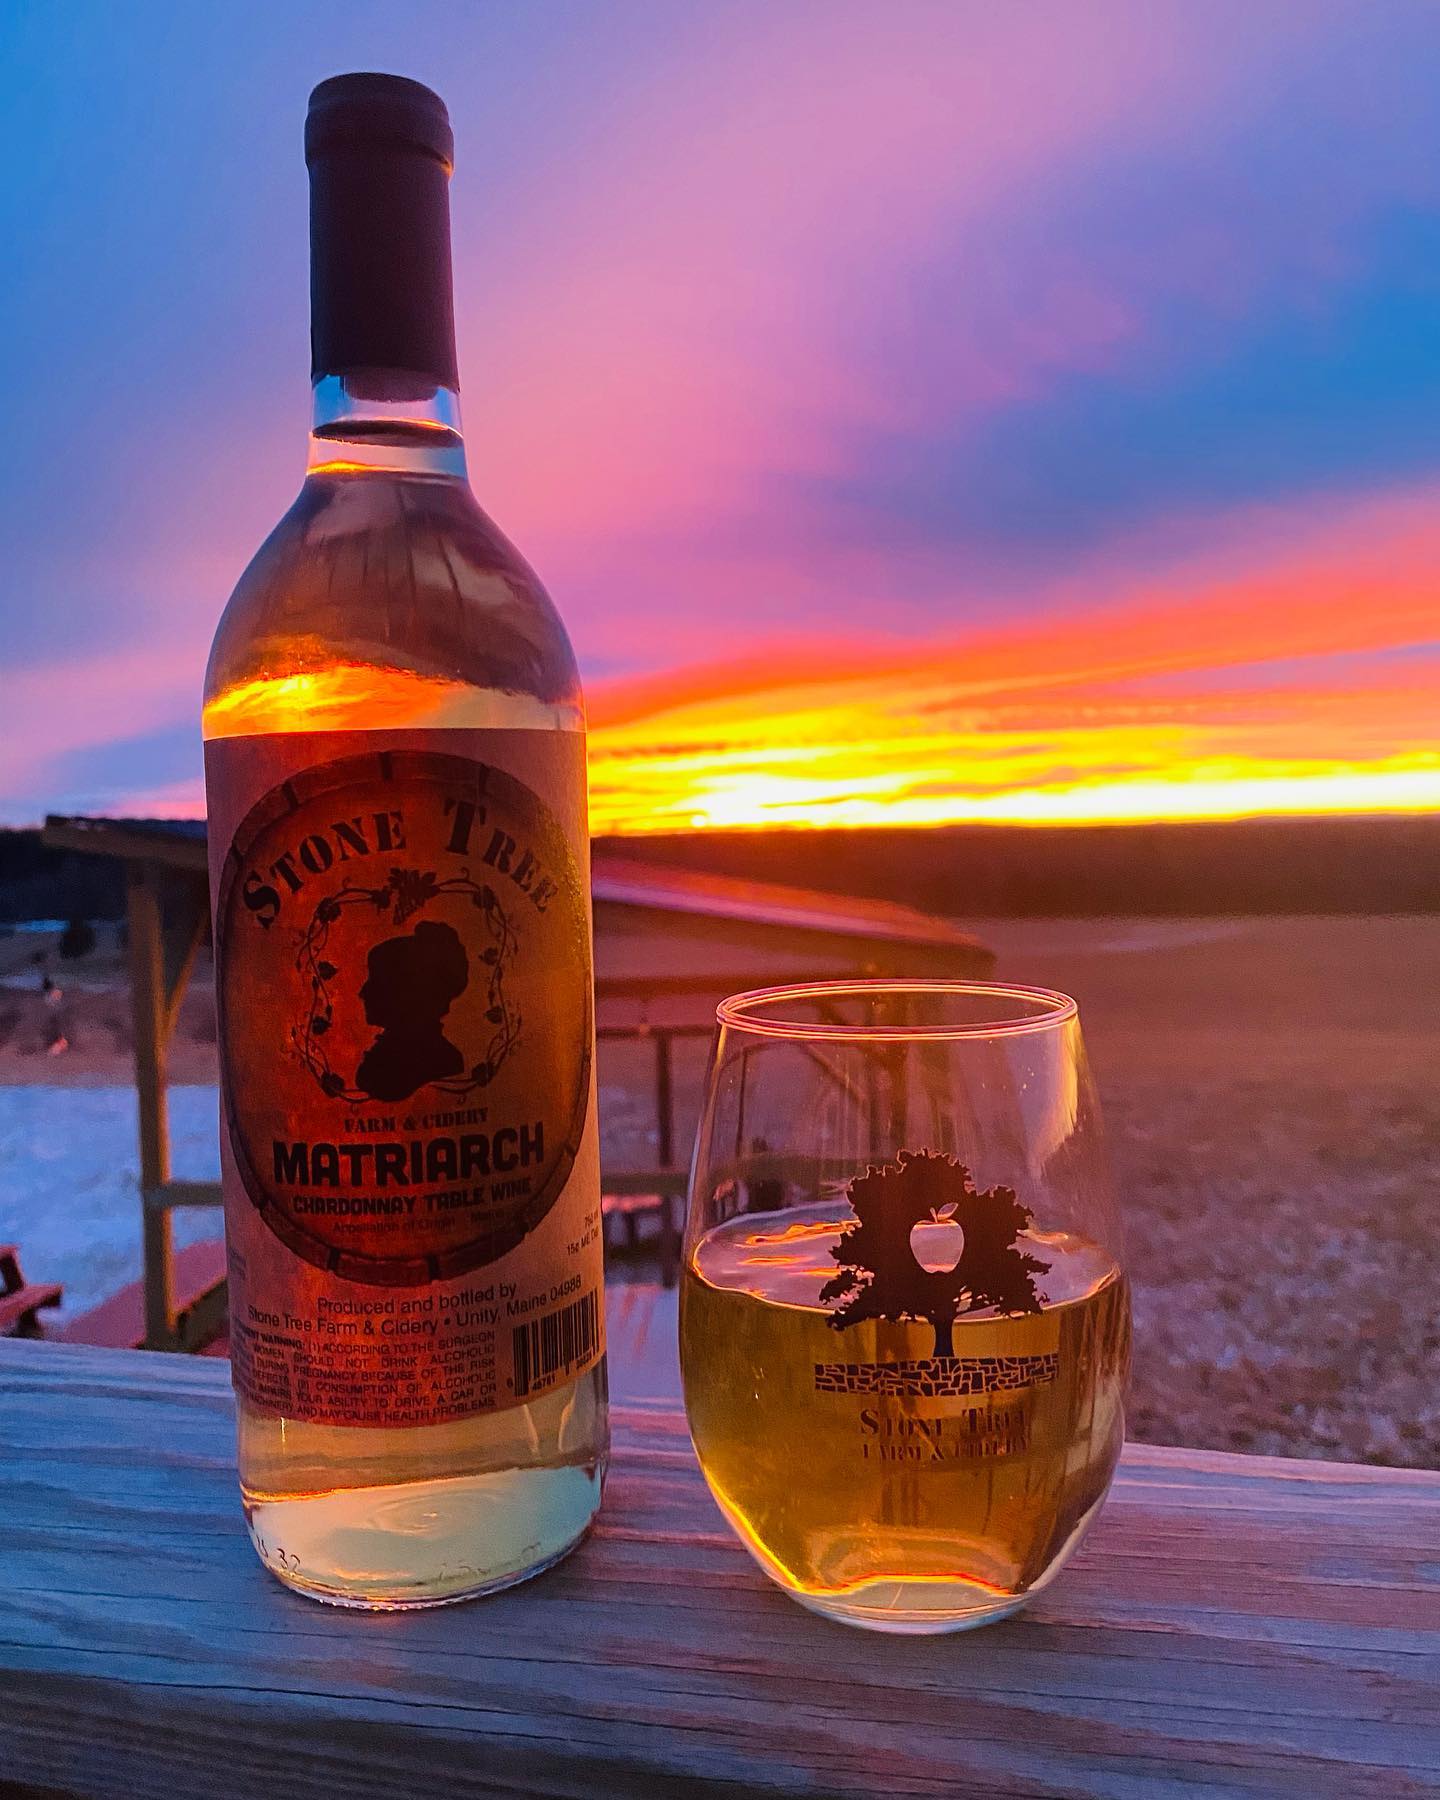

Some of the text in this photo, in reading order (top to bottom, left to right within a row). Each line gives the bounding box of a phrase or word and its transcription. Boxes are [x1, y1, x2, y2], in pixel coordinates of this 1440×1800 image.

[242, 797, 559, 931] STONE TREE
[271, 1120, 545, 1188] MATRIARCH
[293, 1176, 532, 1217] CHARDONNAY TABLE WINE
[248, 1304, 280, 1328] Stone
[284, 1312, 312, 1333] Tree
[317, 1318, 358, 1336] Farm
[363, 1318, 375, 1336] &
[380, 1318, 438, 1337] Cidery
[456, 1307, 501, 1328] Unity,
[506, 1293, 547, 1317] Maine
[550, 1273, 582, 1302] 04988
[317, 1282, 517, 1315] Produced and bottled by
[323, 1342, 390, 1356] ACCORDING
[394, 1344, 408, 1355] TO
[410, 1342, 434, 1353] THE
[345, 1357, 369, 1369] NOT
[381, 1357, 417, 1369] DRINK
[430, 1343, 495, 1365] ALCOHOLIC
[421, 1367, 438, 1379] OF
[470, 1356, 496, 1370] RISK
[316, 1382, 398, 1395] CONSUMPTION
[296, 1405, 318, 1419] AND
[383, 1409, 430, 1421] HEALTH
[394, 1396, 430, 1409] DRIVE
